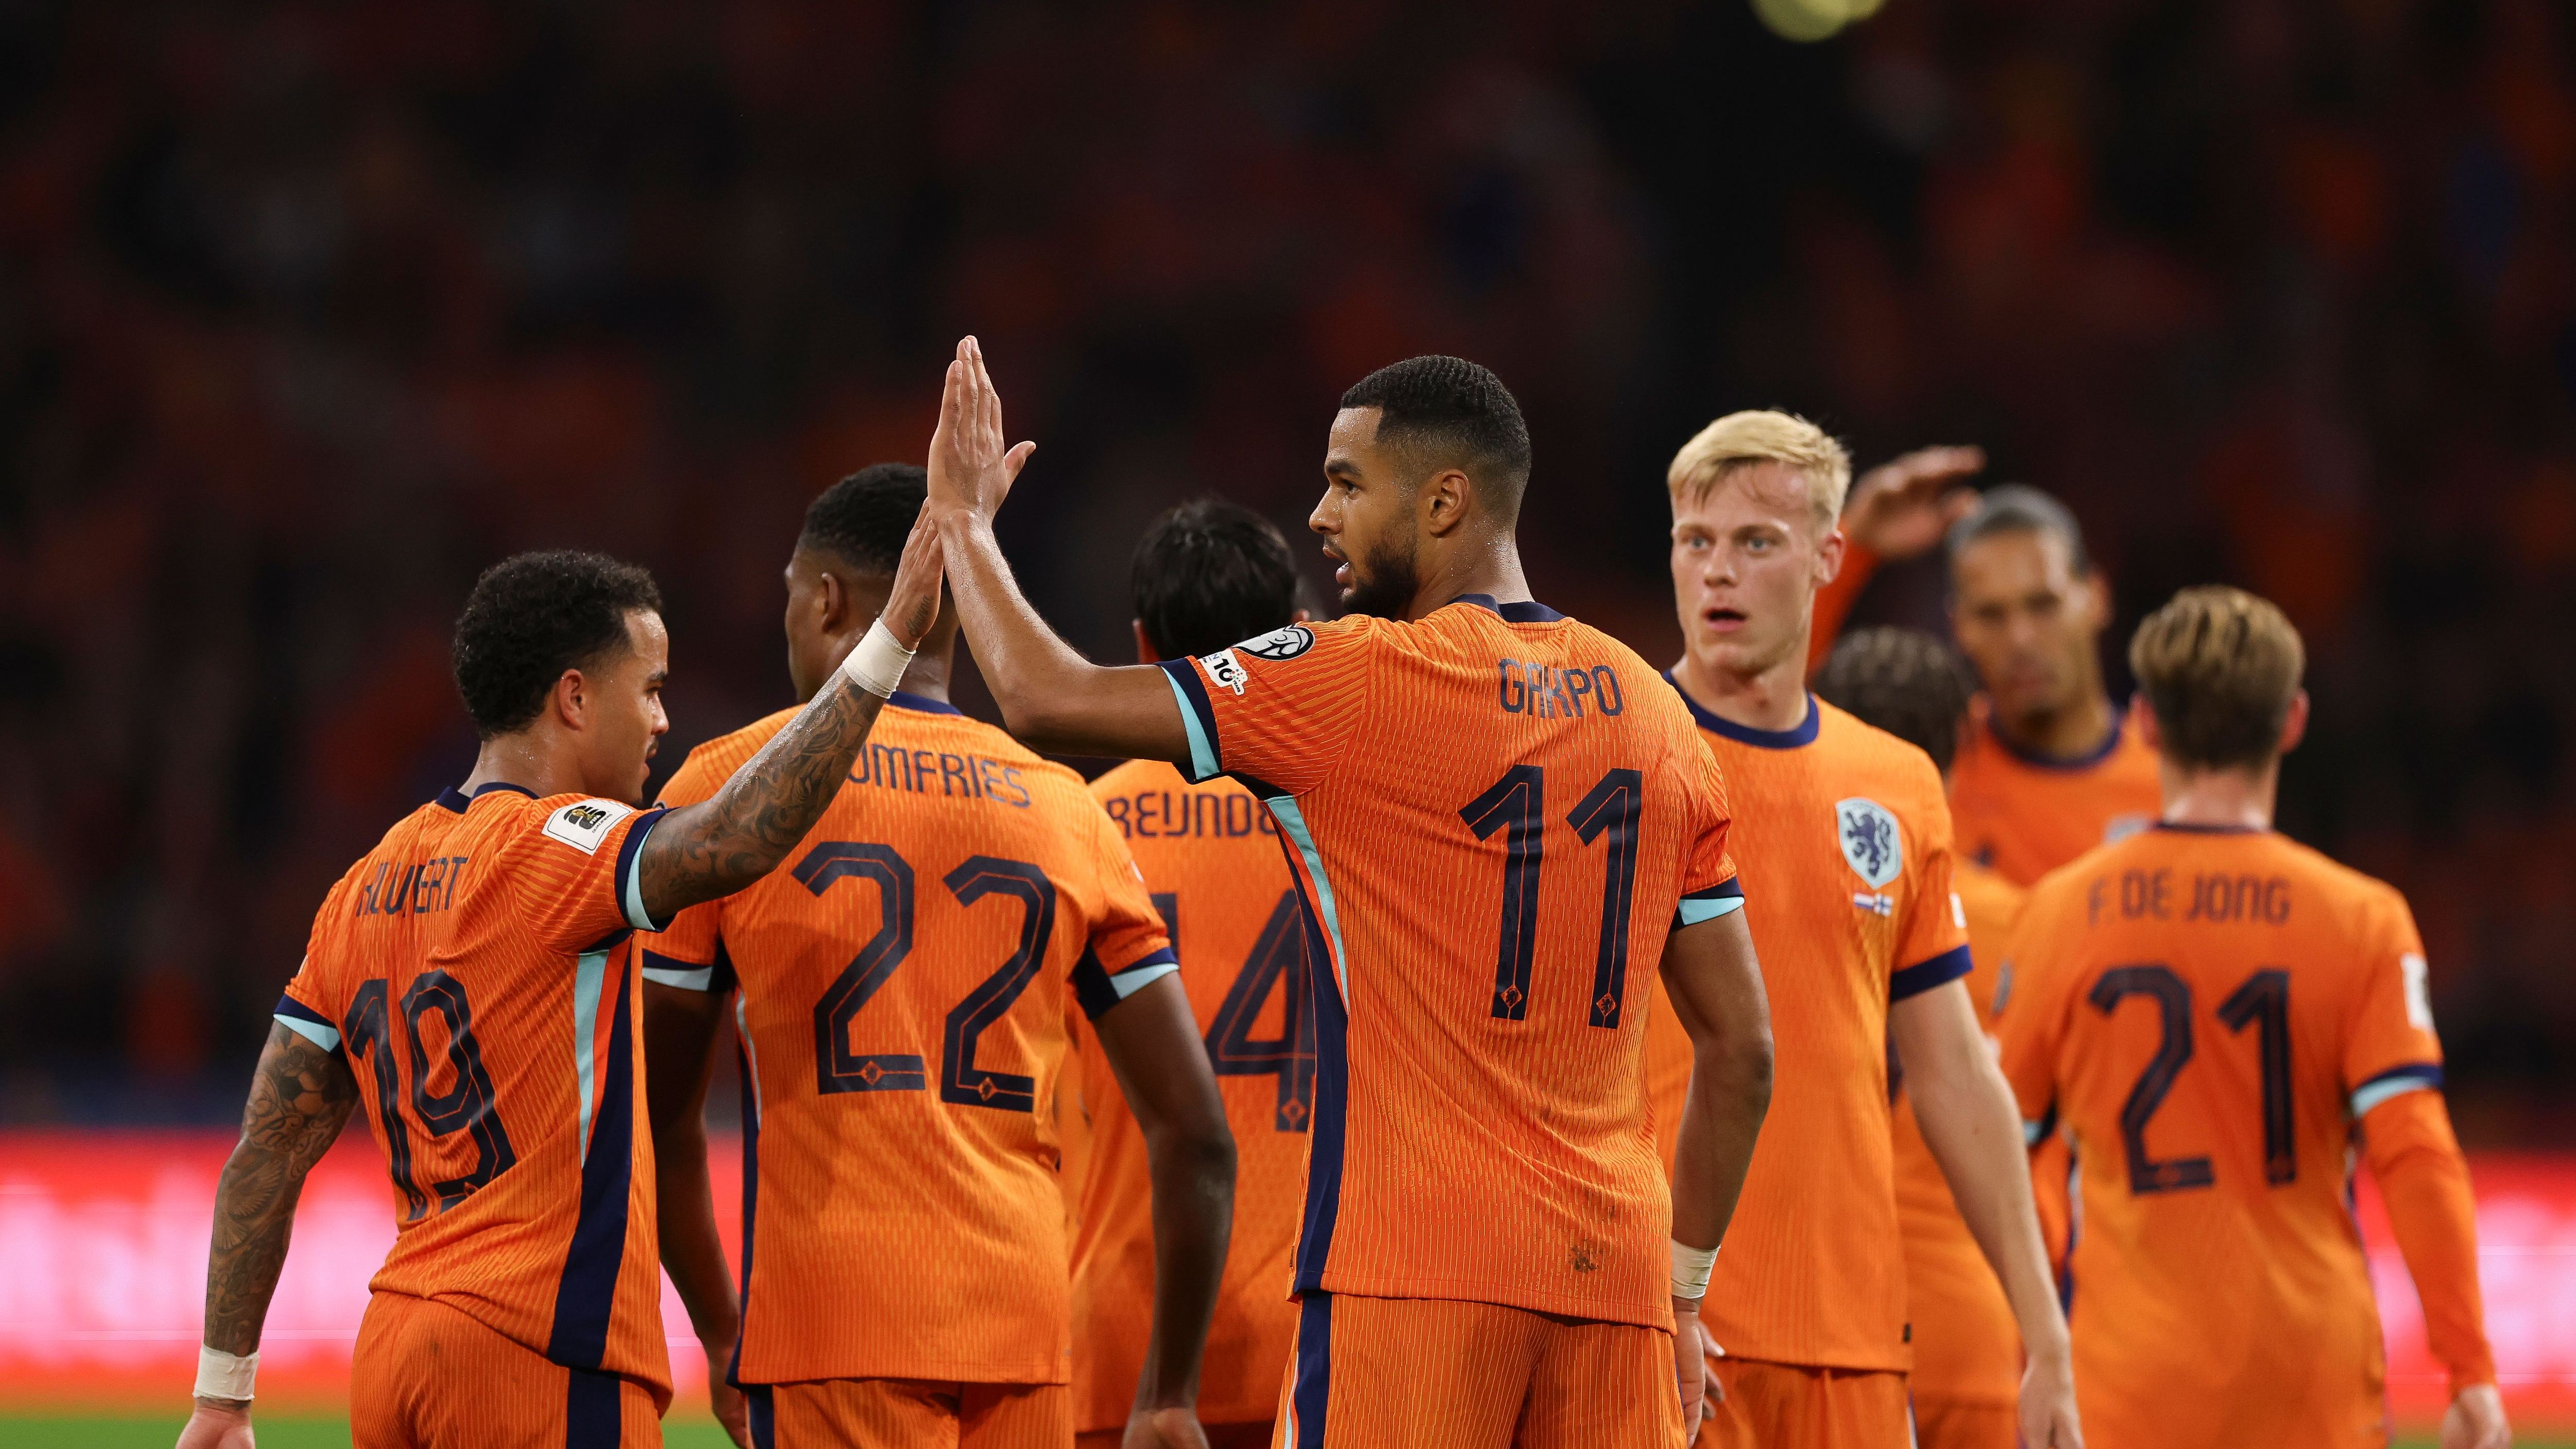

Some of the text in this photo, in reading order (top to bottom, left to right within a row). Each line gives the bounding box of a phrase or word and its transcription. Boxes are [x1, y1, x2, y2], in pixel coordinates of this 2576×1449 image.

[1499, 658, 1623, 719] GAKPO
[848, 743, 1031, 809] UMFRIES
[1106, 792, 1277, 839] REIJNDE
[1458, 764, 1642, 1029] 11
[2121, 867, 2172, 920] DE
[2186, 871, 2291, 925] JONG
[792, 841, 1056, 1113] 22
[344, 969, 517, 1222] 19
[2088, 964, 2296, 1195] 21
